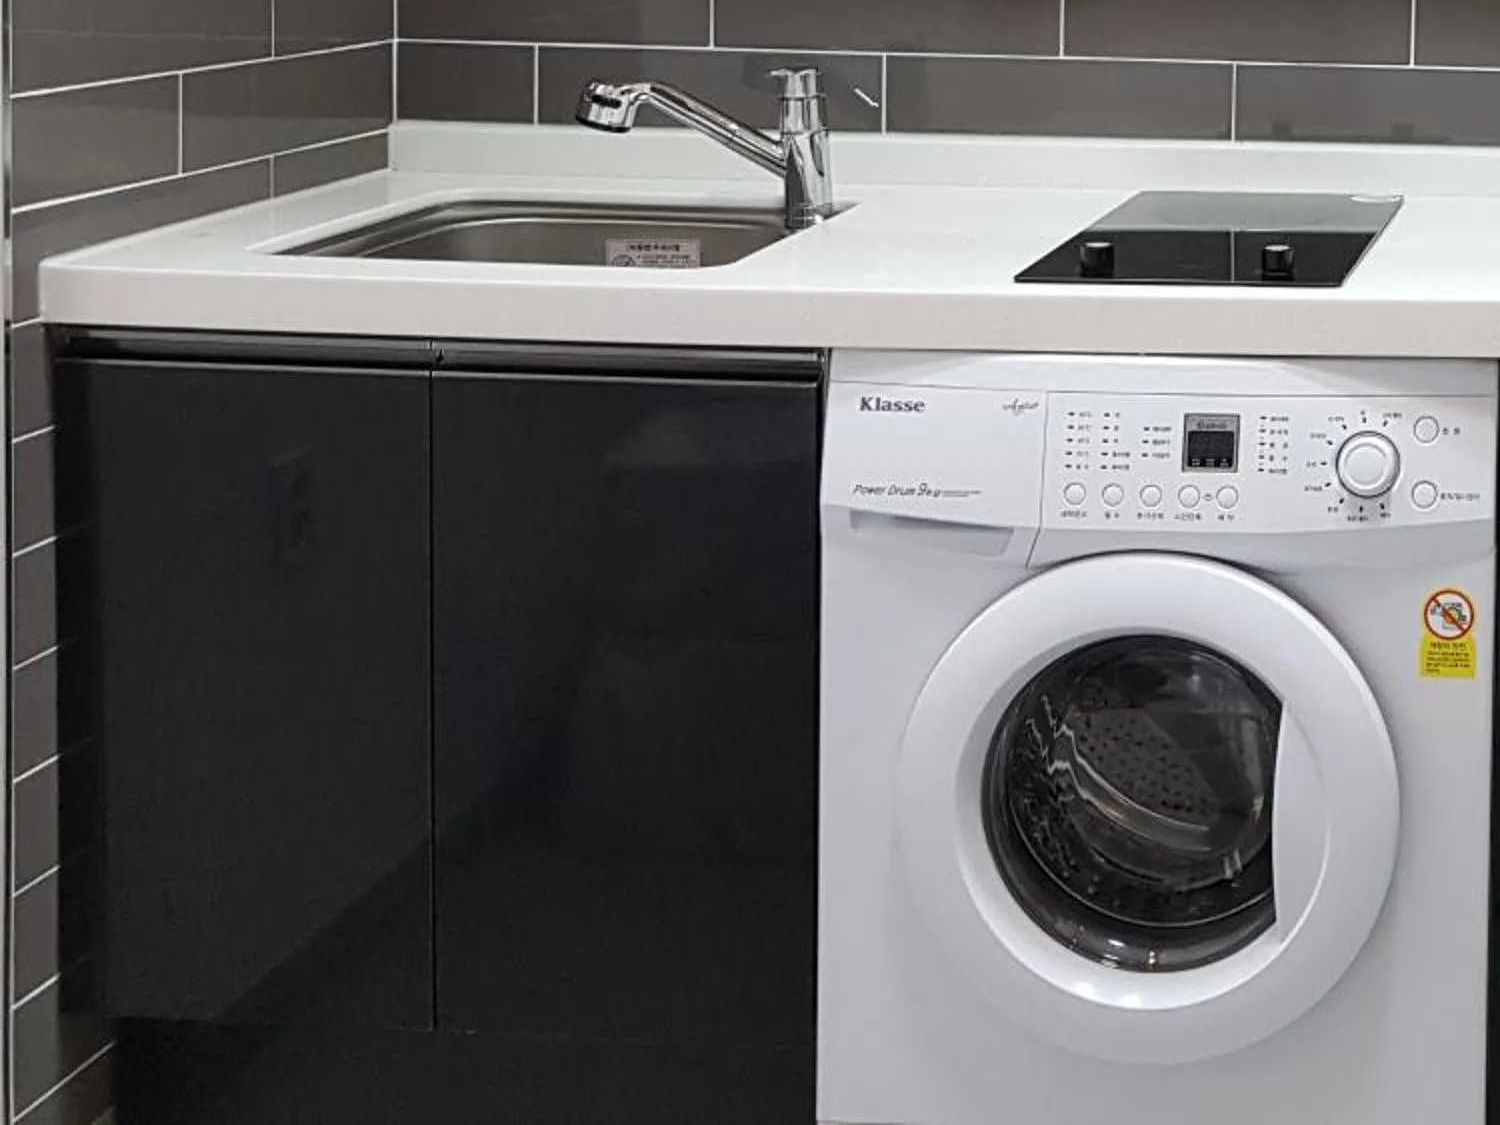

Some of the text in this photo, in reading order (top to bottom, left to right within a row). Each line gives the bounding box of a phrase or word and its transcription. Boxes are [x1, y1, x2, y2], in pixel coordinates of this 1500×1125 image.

[859, 396, 926, 412] Klasse
[852, 483, 886, 496] Power
[887, 484, 916, 496] Drum
